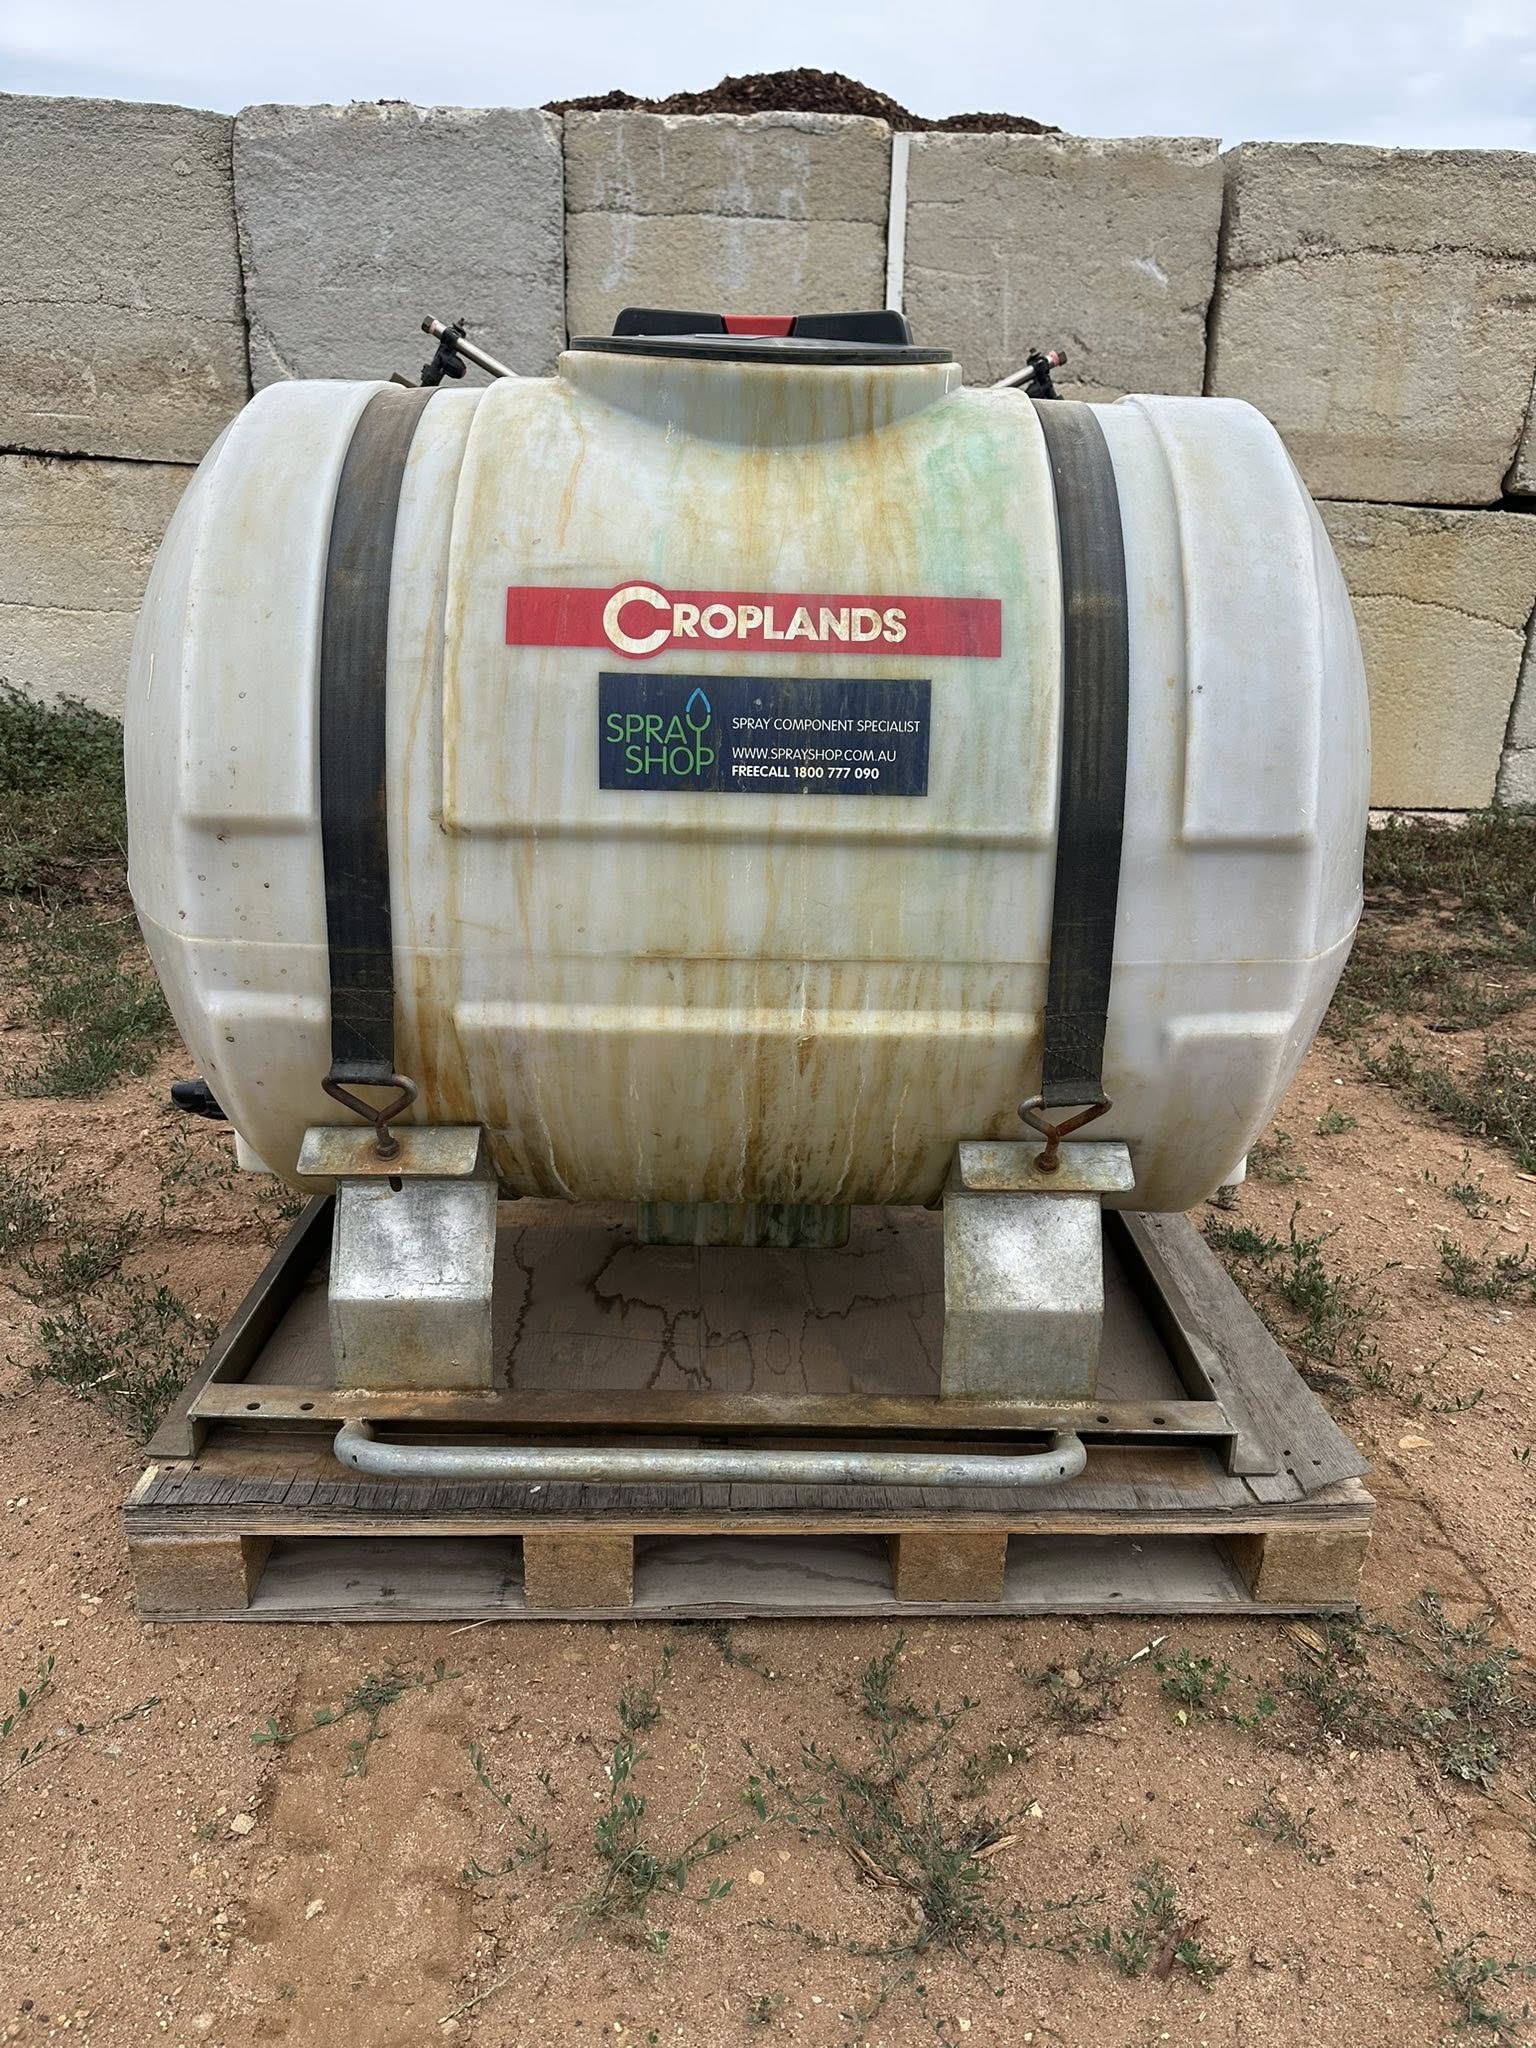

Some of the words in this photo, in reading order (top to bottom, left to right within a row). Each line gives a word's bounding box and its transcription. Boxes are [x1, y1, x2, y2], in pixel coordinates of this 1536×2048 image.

[602, 585, 907, 654] CROPLANDS
[606, 713, 712, 745] SPRAY
[732, 717, 770, 730] SPRAY
[773, 718, 854, 732] COMPONENT
[857, 720, 920, 733] SPECIALIST
[625, 745, 715, 776] SHOP
[732, 747, 897, 762] WWW.SPRAYSHOP.COM.AU
[731, 765, 790, 778] FREECALL
[793, 766, 824, 778] 1800
[827, 767, 851, 779] 777
[854, 767, 880, 780] 090
